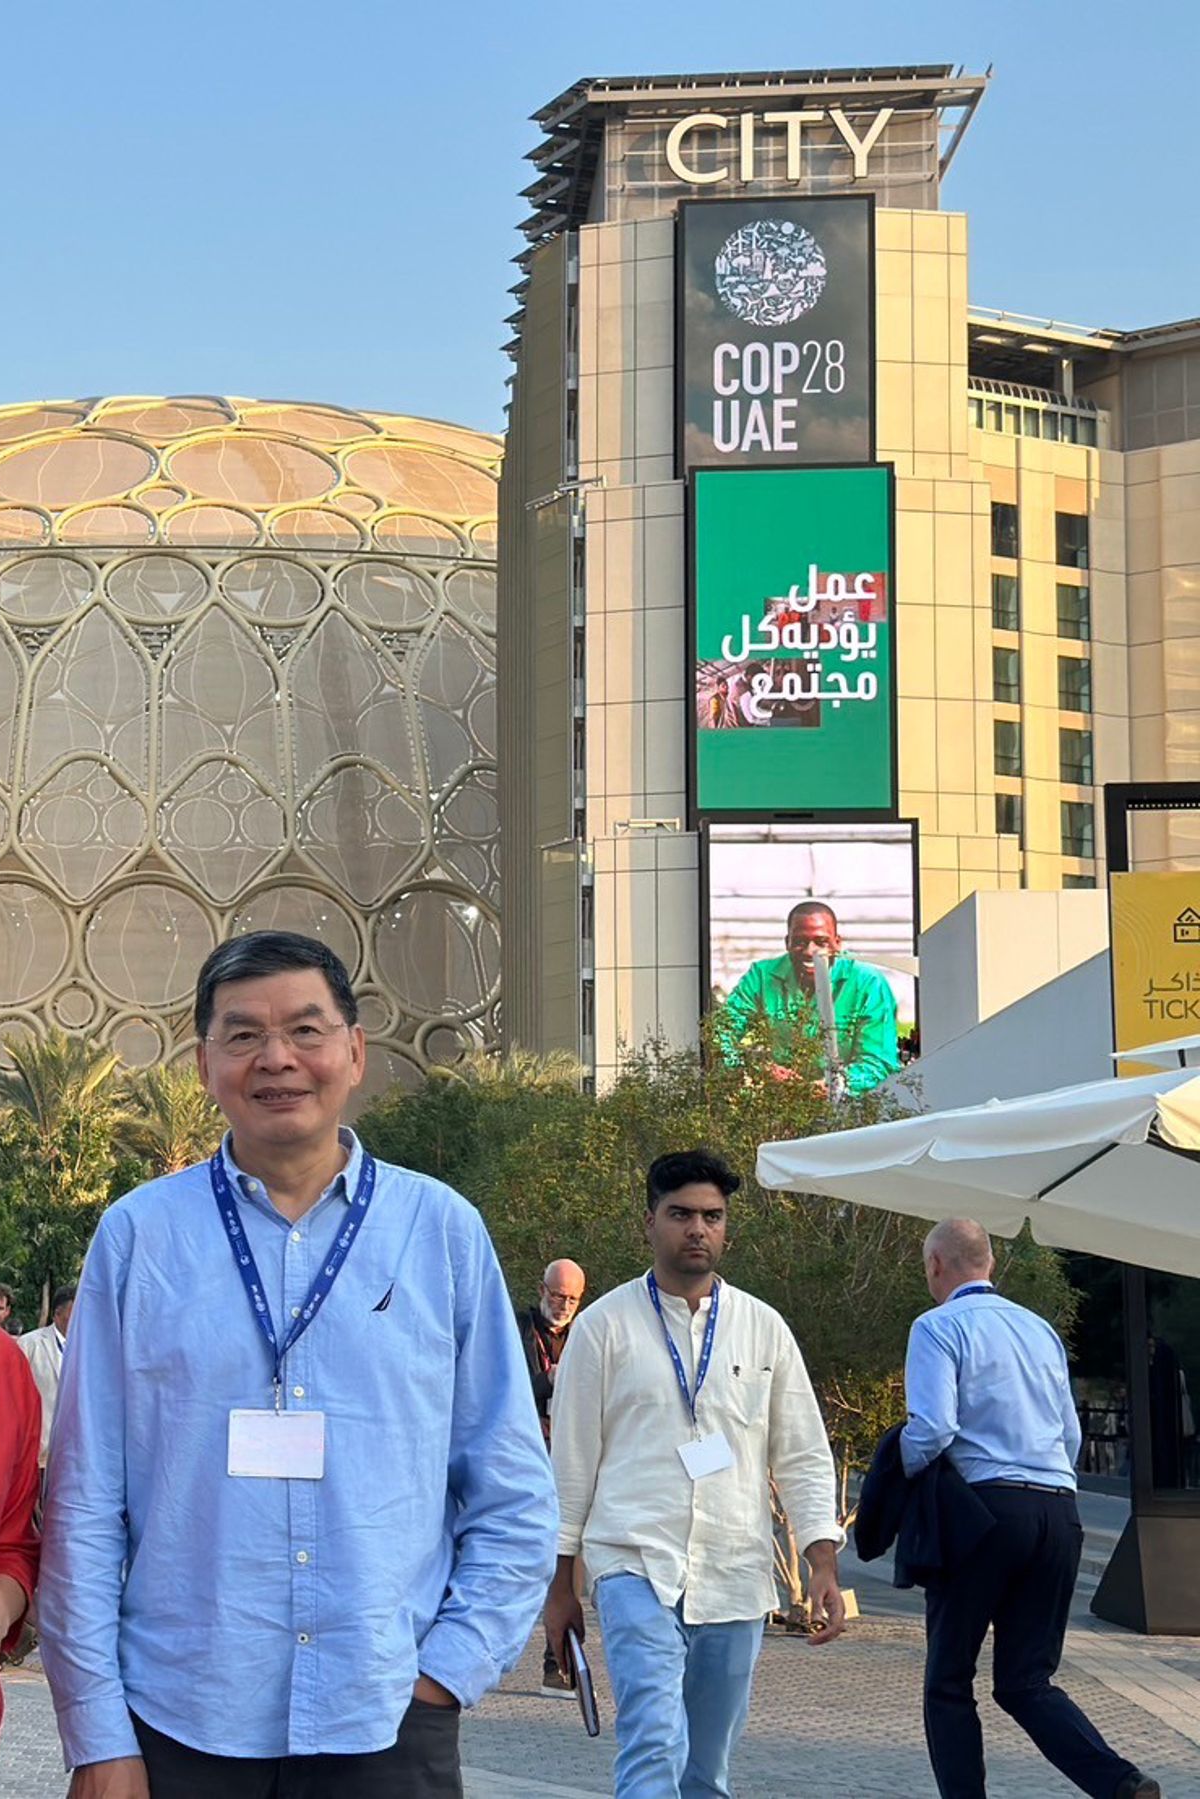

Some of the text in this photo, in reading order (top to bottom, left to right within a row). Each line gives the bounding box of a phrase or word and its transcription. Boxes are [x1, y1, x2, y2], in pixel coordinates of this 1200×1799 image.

[664, 108, 894, 184] CITY
[713, 340, 845, 395] COP28
[713, 398, 798, 452] UAE
[789, 564, 876, 612] عمل
[721, 614, 779, 662] كل
[750, 663, 877, 719] مجتمع
